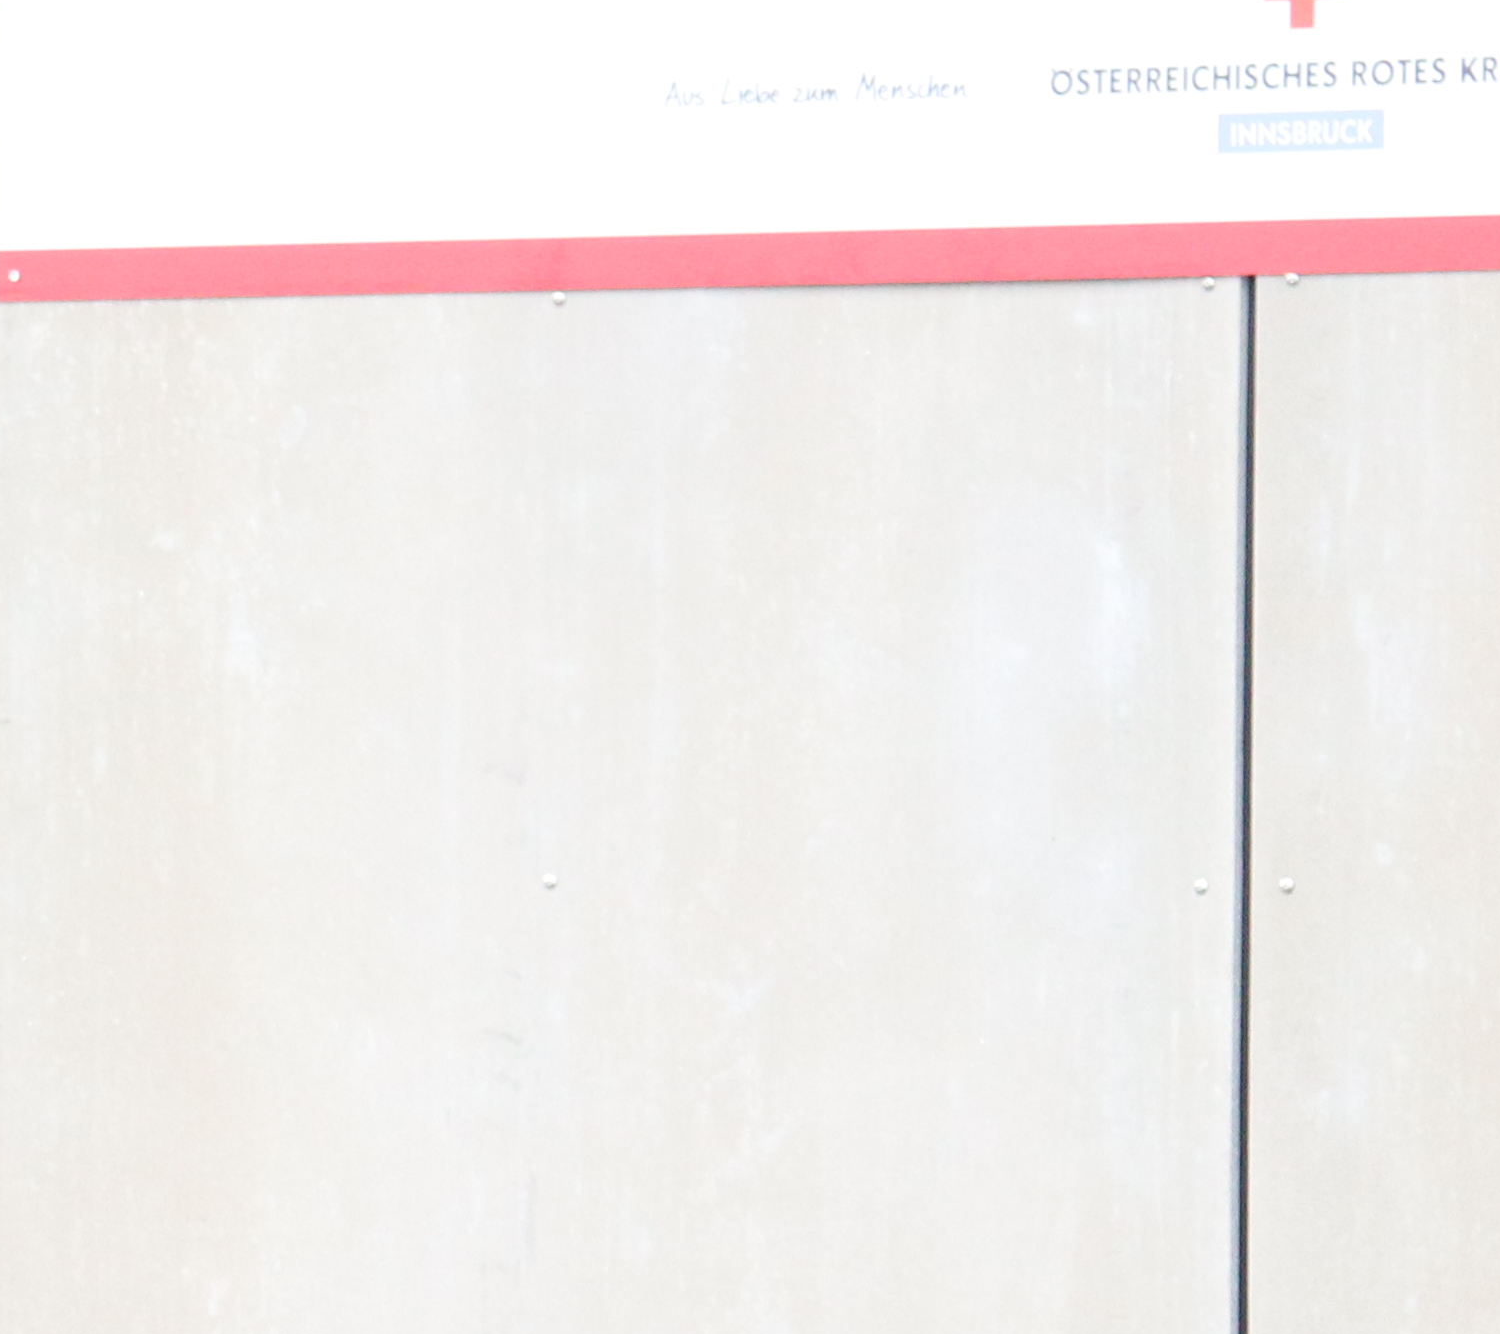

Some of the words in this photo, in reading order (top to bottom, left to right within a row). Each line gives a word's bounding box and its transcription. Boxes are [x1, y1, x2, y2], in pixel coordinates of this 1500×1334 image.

[663, 80, 705, 108] Aus
[720, 77, 780, 105] Liebe
[792, 85, 839, 104] zum
[854, 71, 968, 102] Menschen
[1050, 60, 1338, 96] ÖSTERREICHISCHES
[1351, 57, 1447, 87] ROTES
[1229, 119, 1375, 148] INNSBRUCK
